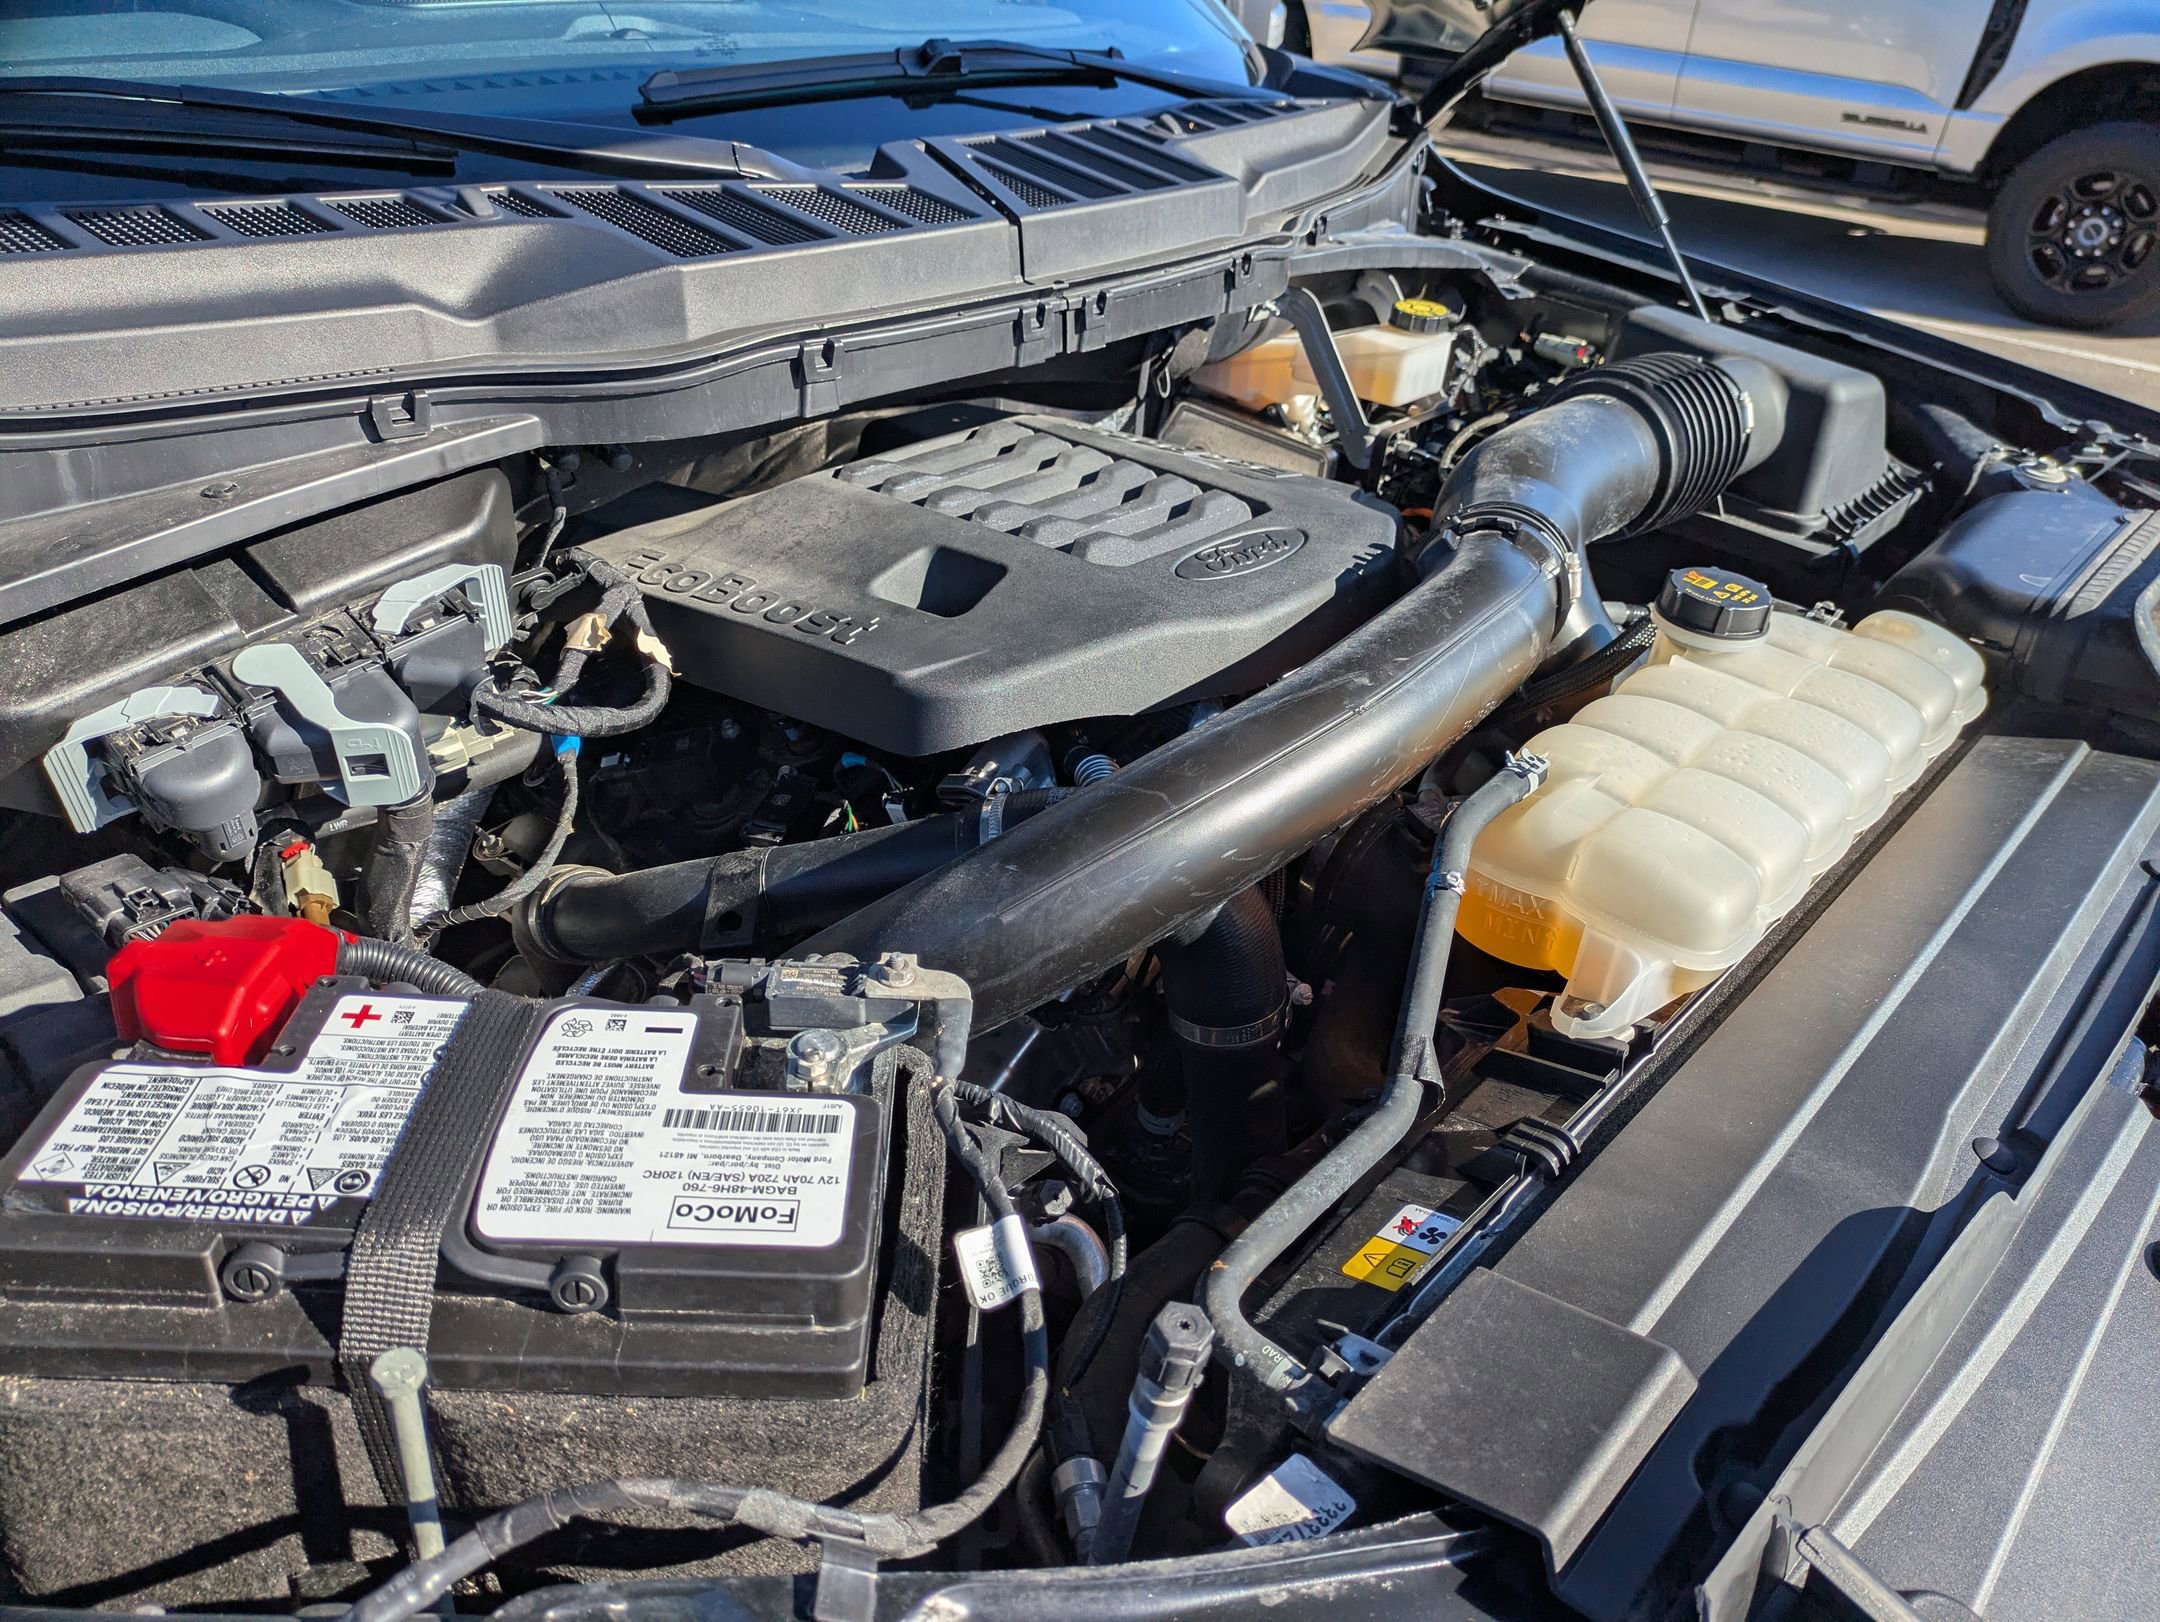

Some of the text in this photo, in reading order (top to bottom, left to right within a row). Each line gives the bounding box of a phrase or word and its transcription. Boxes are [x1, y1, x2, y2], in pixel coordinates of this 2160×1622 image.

[1194, 533, 1290, 574] Ford
[622, 547, 881, 646] EcoBoost
[329, 819, 349, 831] LWR
[1488, 885, 1547, 920] MAX
[1483, 912, 1541, 945] MIN
[341, 1045, 388, 1053] INSTRUCCIONES.
[357, 1053, 400, 1061] INSTRUCTIONS.
[557, 1052, 599, 1060] RECICLARSE
[148, 1076, 196, 1085] RAPIDEMENT.
[547, 1080, 601, 1088] ATTENTIVEMENT
[148, 1085, 190, 1093] CONSULTEZ
[531, 1086, 573, 1094] UTILISATION
[151, 1101, 180, 1109] RINCEZ
[126, 1110, 144, 1118] CON
[298, 1112, 326, 1120] ÉVITER
[150, 1120, 168, 1128] CON
[584, 1122, 623, 1130] CORRECTAS
[72, 1125, 141, 1135] INMEDIATAMENTE
[98, 1135, 156, 1145] ENJUAGUE LOS
[52, 1143, 75, 1151] FAST.
[97, 1146, 133, 1154] MEDICAL
[532, 1142, 565, 1150] INCINERE.
[575, 1144, 613, 1152] DESMONTE
[527, 1150, 577, 1158] QUEMADURAS.
[702, 1153, 742, 1161] Dearborn,
[746, 1154, 786, 1162] Company,
[91, 1156, 142, 1166] WITH WATER.
[558, 1158, 584, 1166] RIESGO
[82, 1163, 137, 1173] IMMEDIATELY
[763, 1162, 782, 1170] Dist.
[83, 1171, 132, 1181] FLUSH EYES
[183, 1175, 222, 1184] SULFURIC
[279, 1175, 292, 1183] NO
[524, 1172, 579, 1181] INSTRUCTIONS.
[643, 1170, 840, 1185] 12V 70Ah 720A (SAE/EN) 120RC
[509, 1180, 540, 1188] PROPER
[513, 1188, 571, 1196] RECOMMENDED
[683, 1183, 798, 1195] BAGM-48H6-760
[101, 1185, 316, 1208] PELIGRO/VENENO
[513, 1196, 565, 1204] DISASSEMBLE
[85, 1200, 287, 1223] DANGER/POISON
[499, 1204, 542, 1212] EXPLOSION
[545, 1205, 563, 1213] FIRE,
[595, 1207, 632, 1215] WARNING:
[676, 1204, 796, 1225] FoMoCo
[979, 1292, 996, 1304] OK
[1262, 1345, 1284, 1363] RAD
